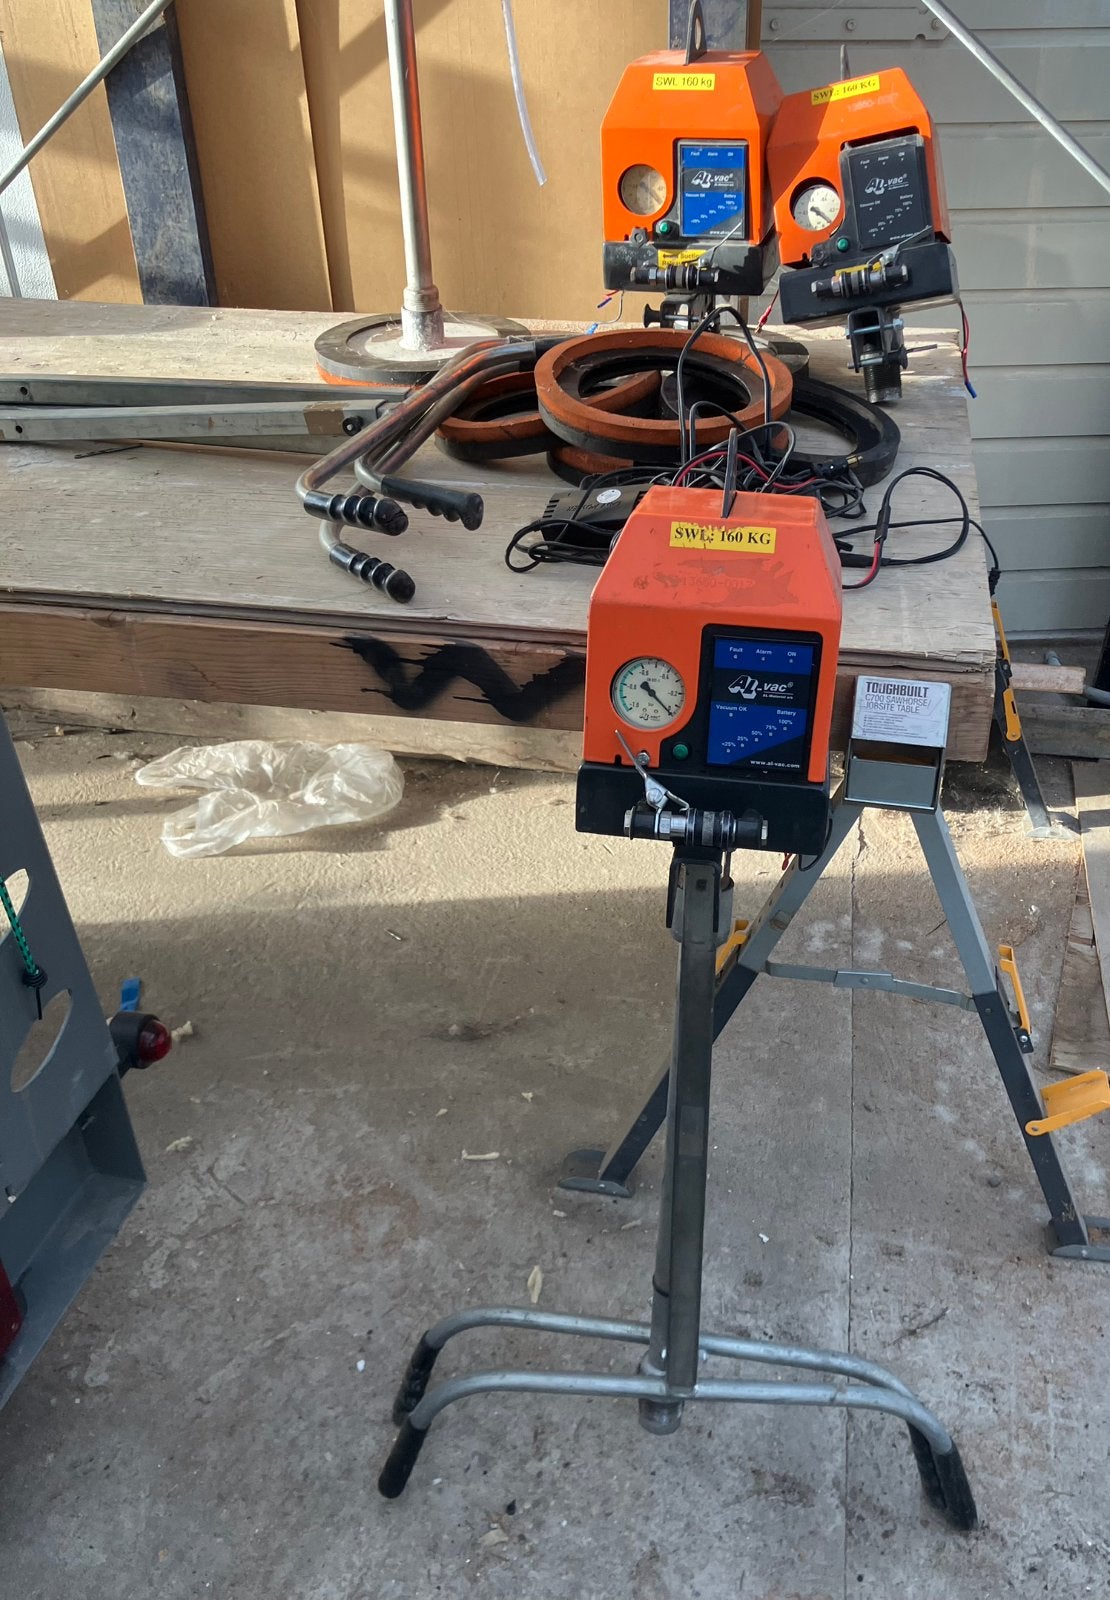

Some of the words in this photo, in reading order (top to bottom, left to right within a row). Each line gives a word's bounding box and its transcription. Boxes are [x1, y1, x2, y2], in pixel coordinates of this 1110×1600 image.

[655, 76, 678, 87] SWL
[682, 76, 699, 87] 160
[701, 77, 713, 89] kg
[843, 84, 858, 94] 160
[674, 526, 714, 544] SWL:
[720, 530, 743, 543] 160
[747, 531, 771, 545] KG
[865, 681, 930, 698] TOUGHBUILT
[865, 693, 885, 703] C700
[776, 709, 796, 717] Battery
[864, 701, 894, 711] JOBSITE
[897, 705, 920, 714] TABLE
[750, 759, 800, 769] www.al-vac.com
